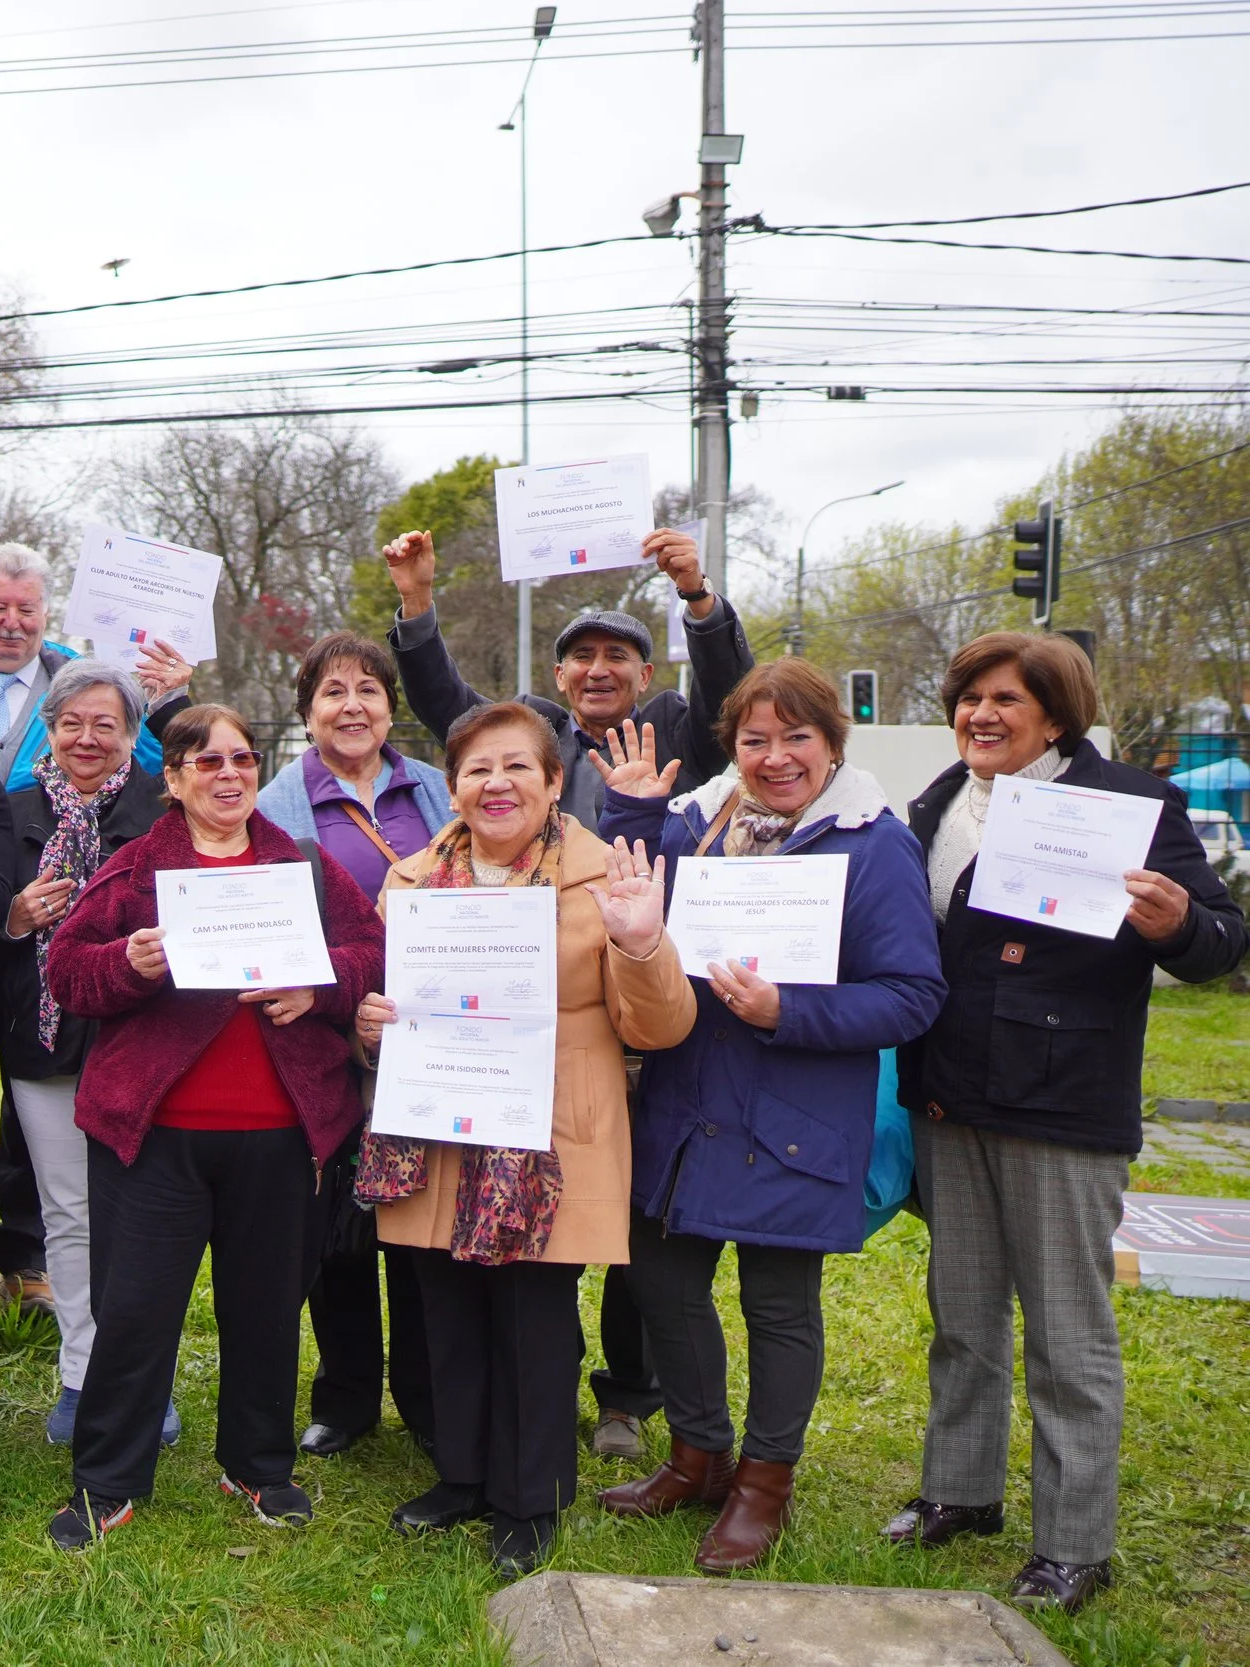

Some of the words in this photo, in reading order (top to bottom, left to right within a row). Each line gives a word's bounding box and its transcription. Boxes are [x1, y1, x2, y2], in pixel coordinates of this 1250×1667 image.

[541, 505, 583, 516] MUCHACHOS
[595, 500, 622, 508] AGOSTO
[106, 570, 128, 580] ADULTO
[129, 576, 149, 585] MAYOR
[150, 580, 174, 592] ARCOIRIS
[182, 589, 204, 600] NUESTRO
[132, 584, 164, 596] ATARDECER
[1034, 842, 1051, 852] CAM
[1053, 846, 1088, 859] AMISTAD
[782, 898, 818, 906] CORAZÓN
[193, 926, 211, 934] CAM
[230, 922, 256, 931] PEDRO
[257, 920, 292, 928] NOLASCO
[456, 1065, 488, 1074] ISIDORO
[490, 1068, 510, 1076] TOHA
